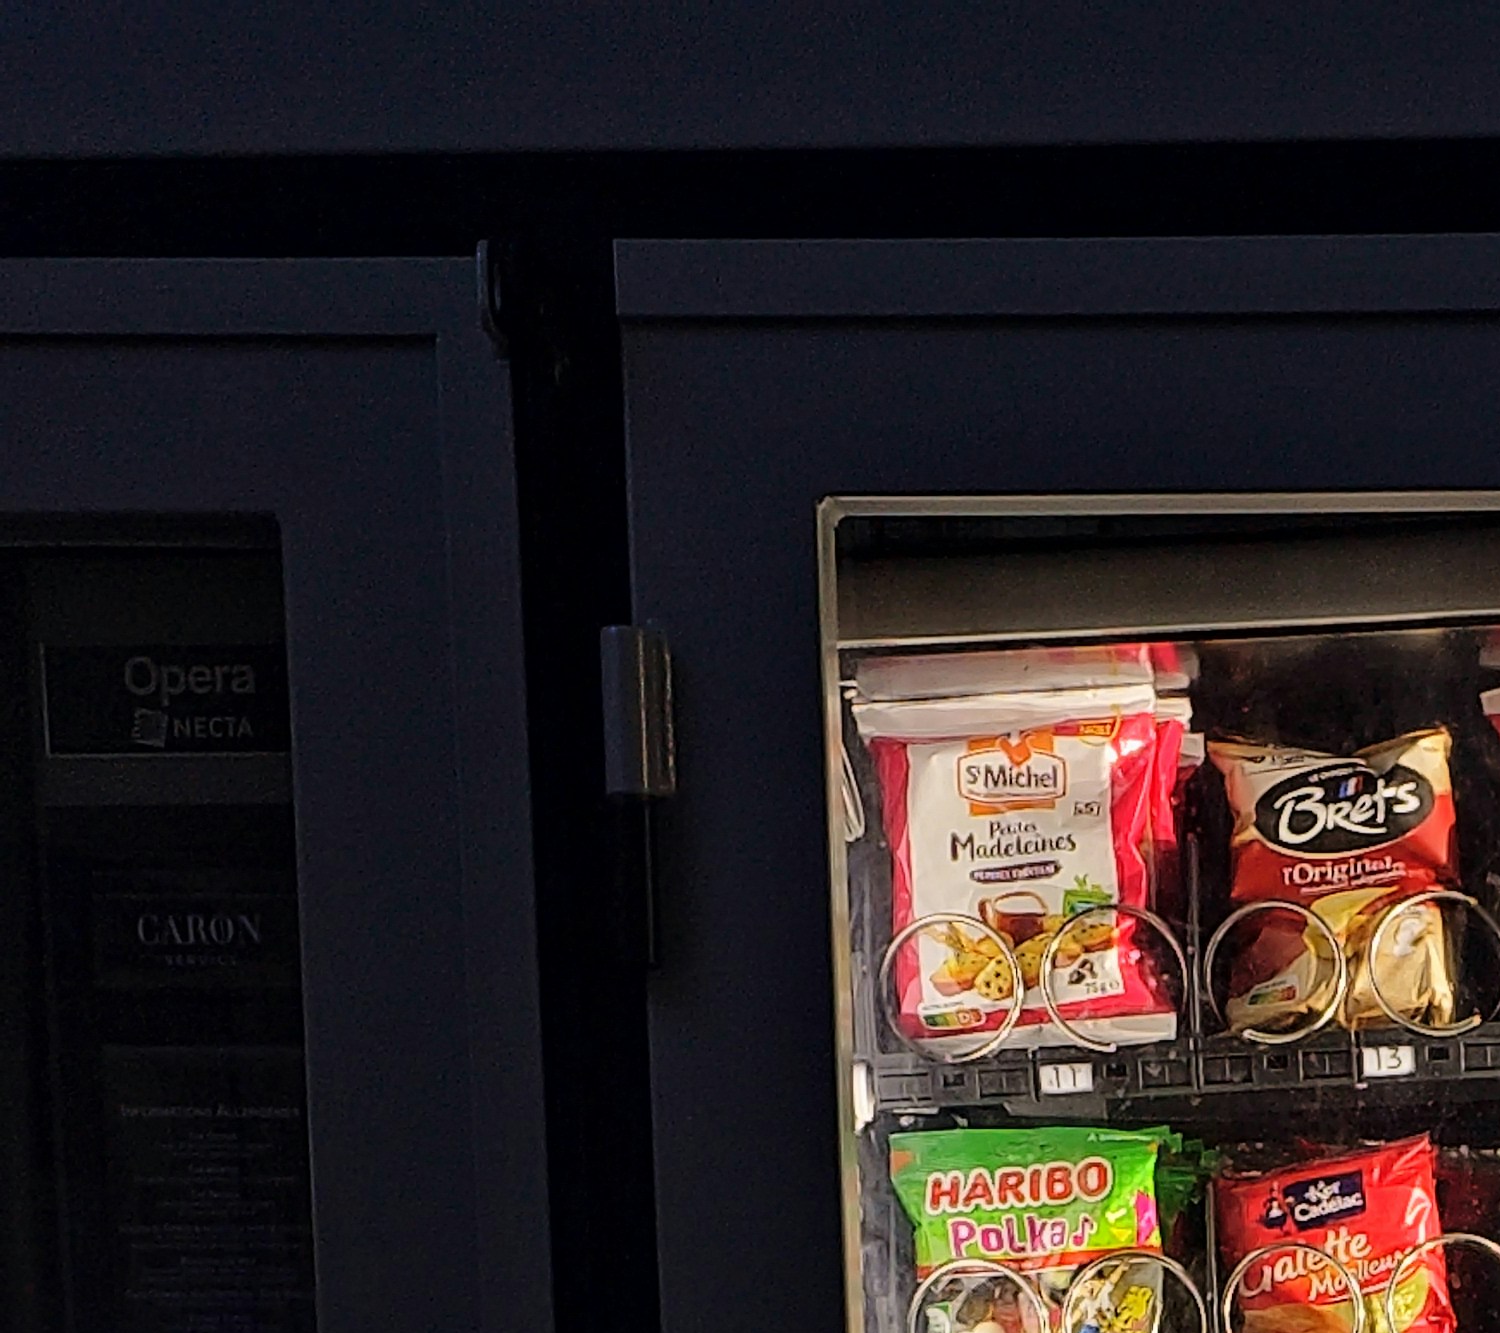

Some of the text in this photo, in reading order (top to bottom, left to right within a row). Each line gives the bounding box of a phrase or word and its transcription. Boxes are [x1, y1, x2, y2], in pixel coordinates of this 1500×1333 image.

[124, 655, 257, 707] Opera
[172, 715, 255, 740] NECTA
[983, 761, 1059, 791] Michel
[950, 832, 1077, 863] Madeleines
[136, 912, 263, 946] CARON
[1374, 1048, 1402, 1070] 13
[929, 1160, 1110, 1211] HARIBO
